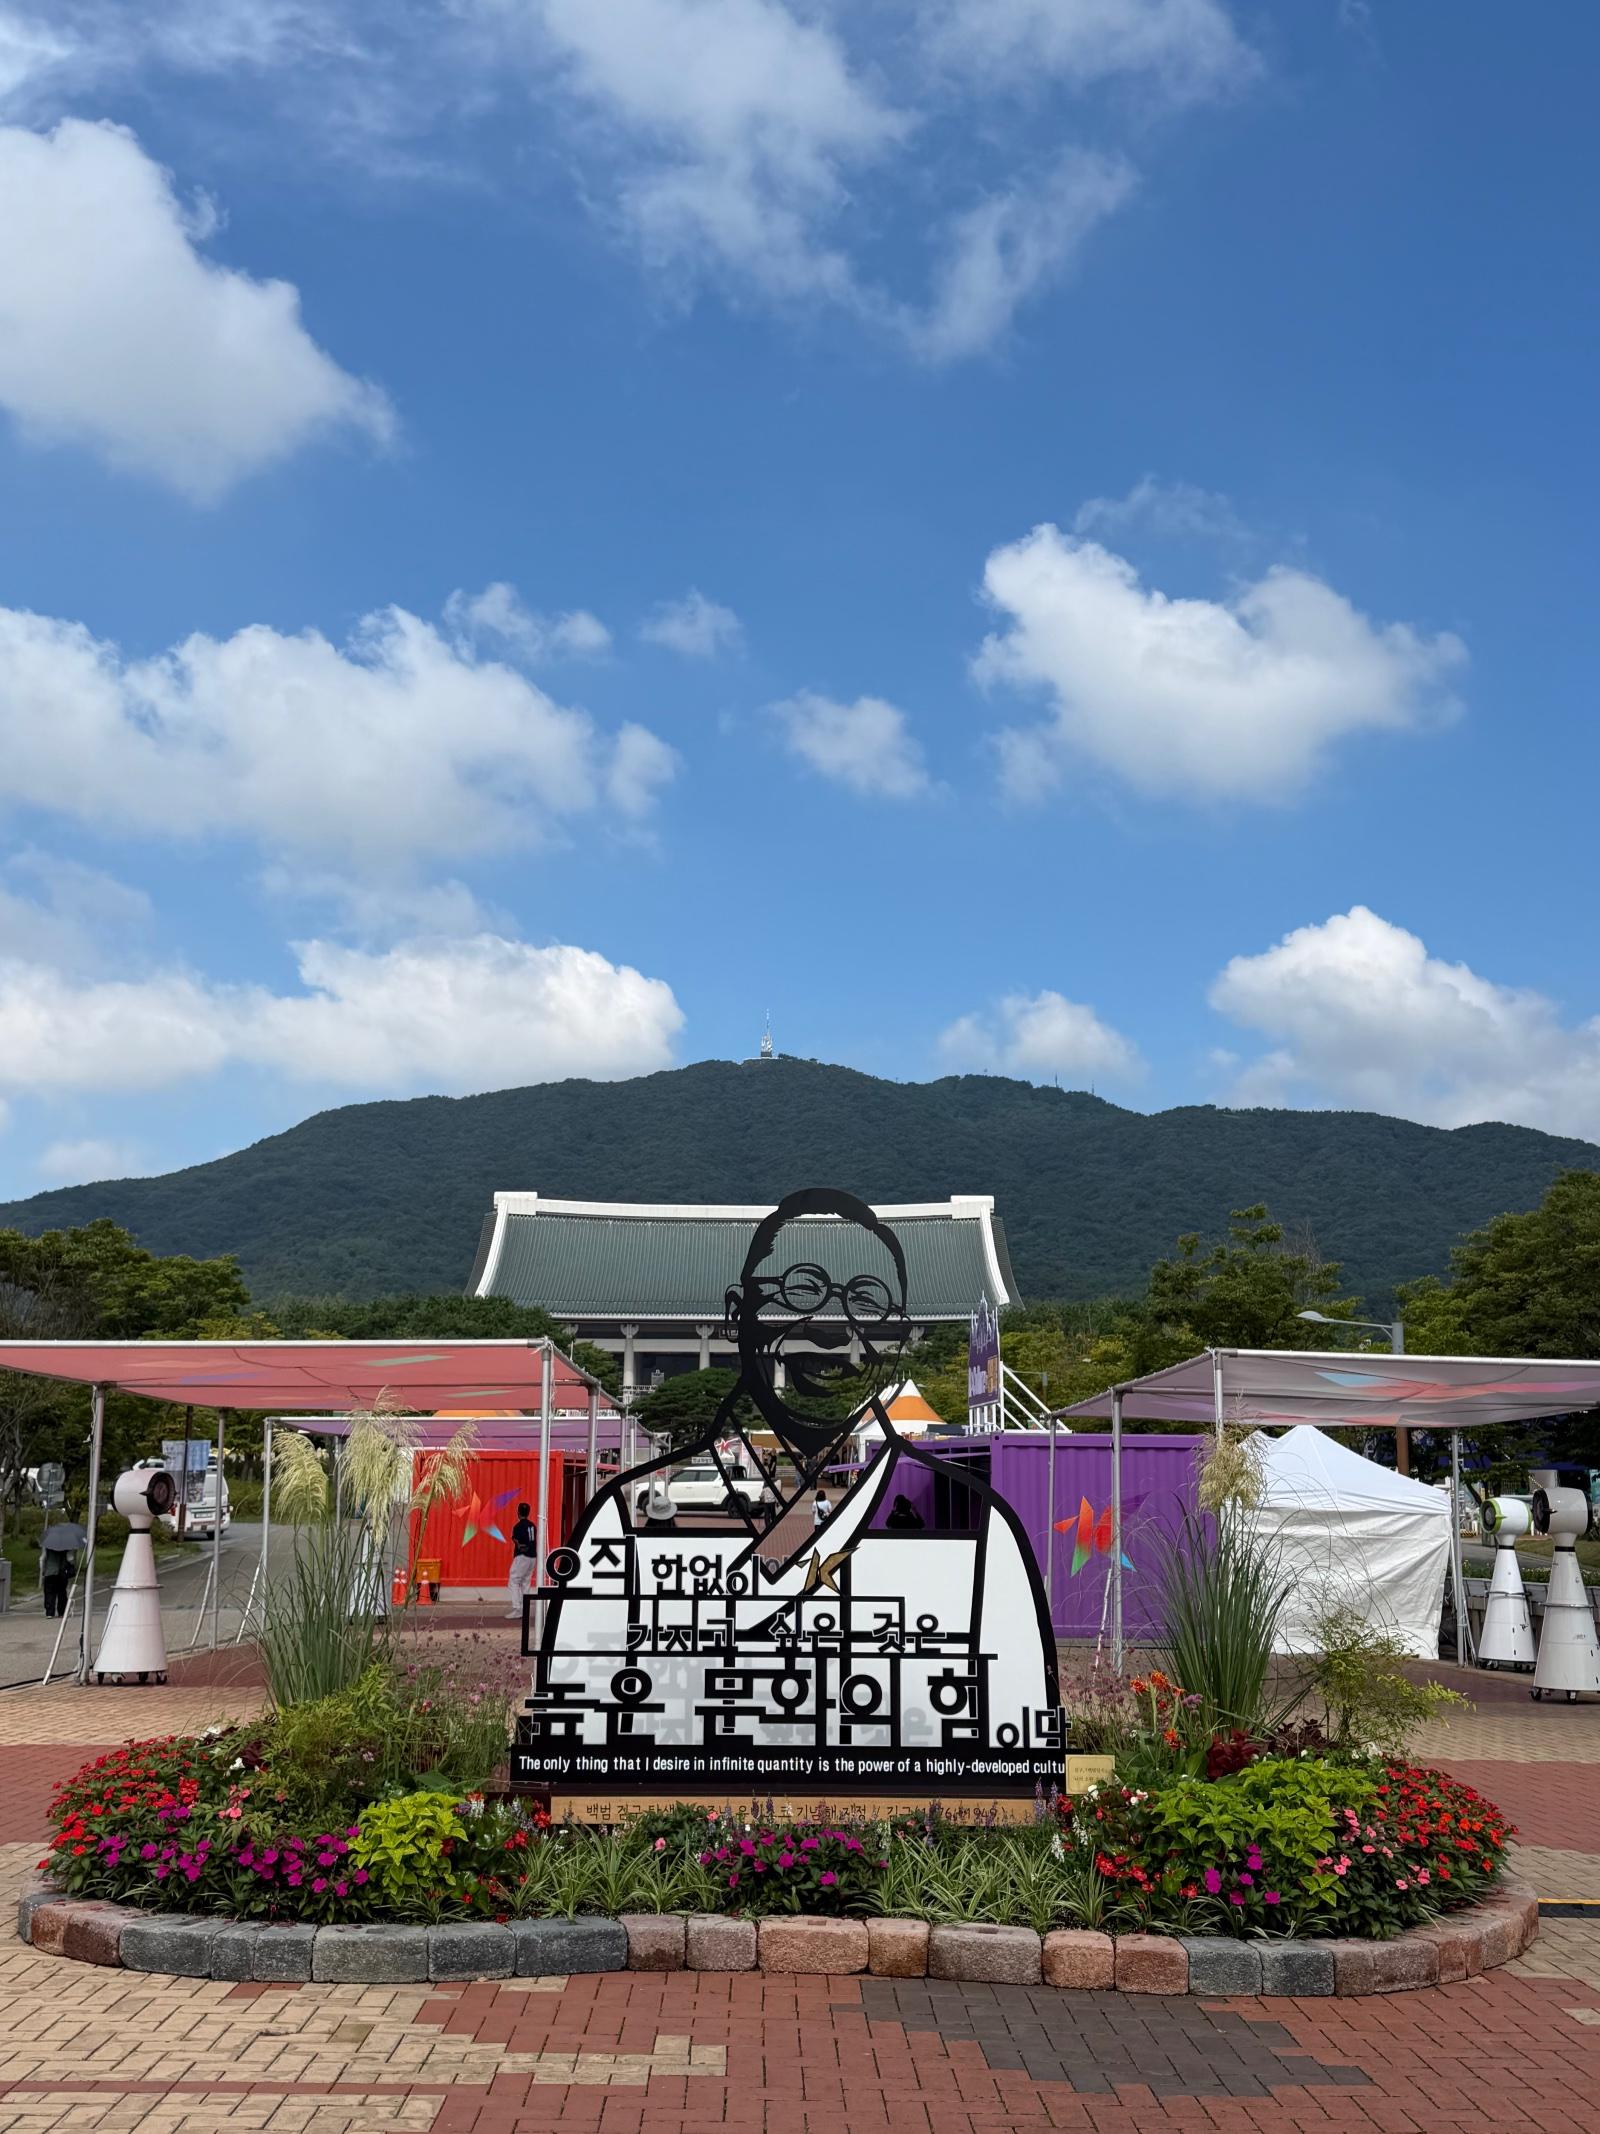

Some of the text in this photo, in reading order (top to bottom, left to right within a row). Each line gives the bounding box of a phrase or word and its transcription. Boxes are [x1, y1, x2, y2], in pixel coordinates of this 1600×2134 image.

[537, 1535, 760, 1598] 오직 한없이
[627, 1610, 948, 1654] 가지고 싶은 것은
[524, 1667, 665, 1748] 높은
[695, 1665, 901, 1748] 문화의
[518, 1755, 541, 1770] The
[543, 1755, 571, 1773] only
[575, 1755, 609, 1774] thing
[613, 1756, 641, 1771] that
[652, 1756, 691, 1771] desire
[693, 1756, 705, 1771] in
[709, 1756, 755, 1771] infinite
[757, 1756, 814, 1774] quantity
[818, 1756, 830, 1772] is
[834, 1757, 855, 1772] the
[858, 1760, 895, 1775] power
[897, 1758, 911, 1773] of
[926, 1758, 1030, 1777] highly-developed
[1033, 1759, 1065, 1774] cultu
[586, 1802, 611, 1821] 백범
[616, 1802, 643, 1821] 김구
